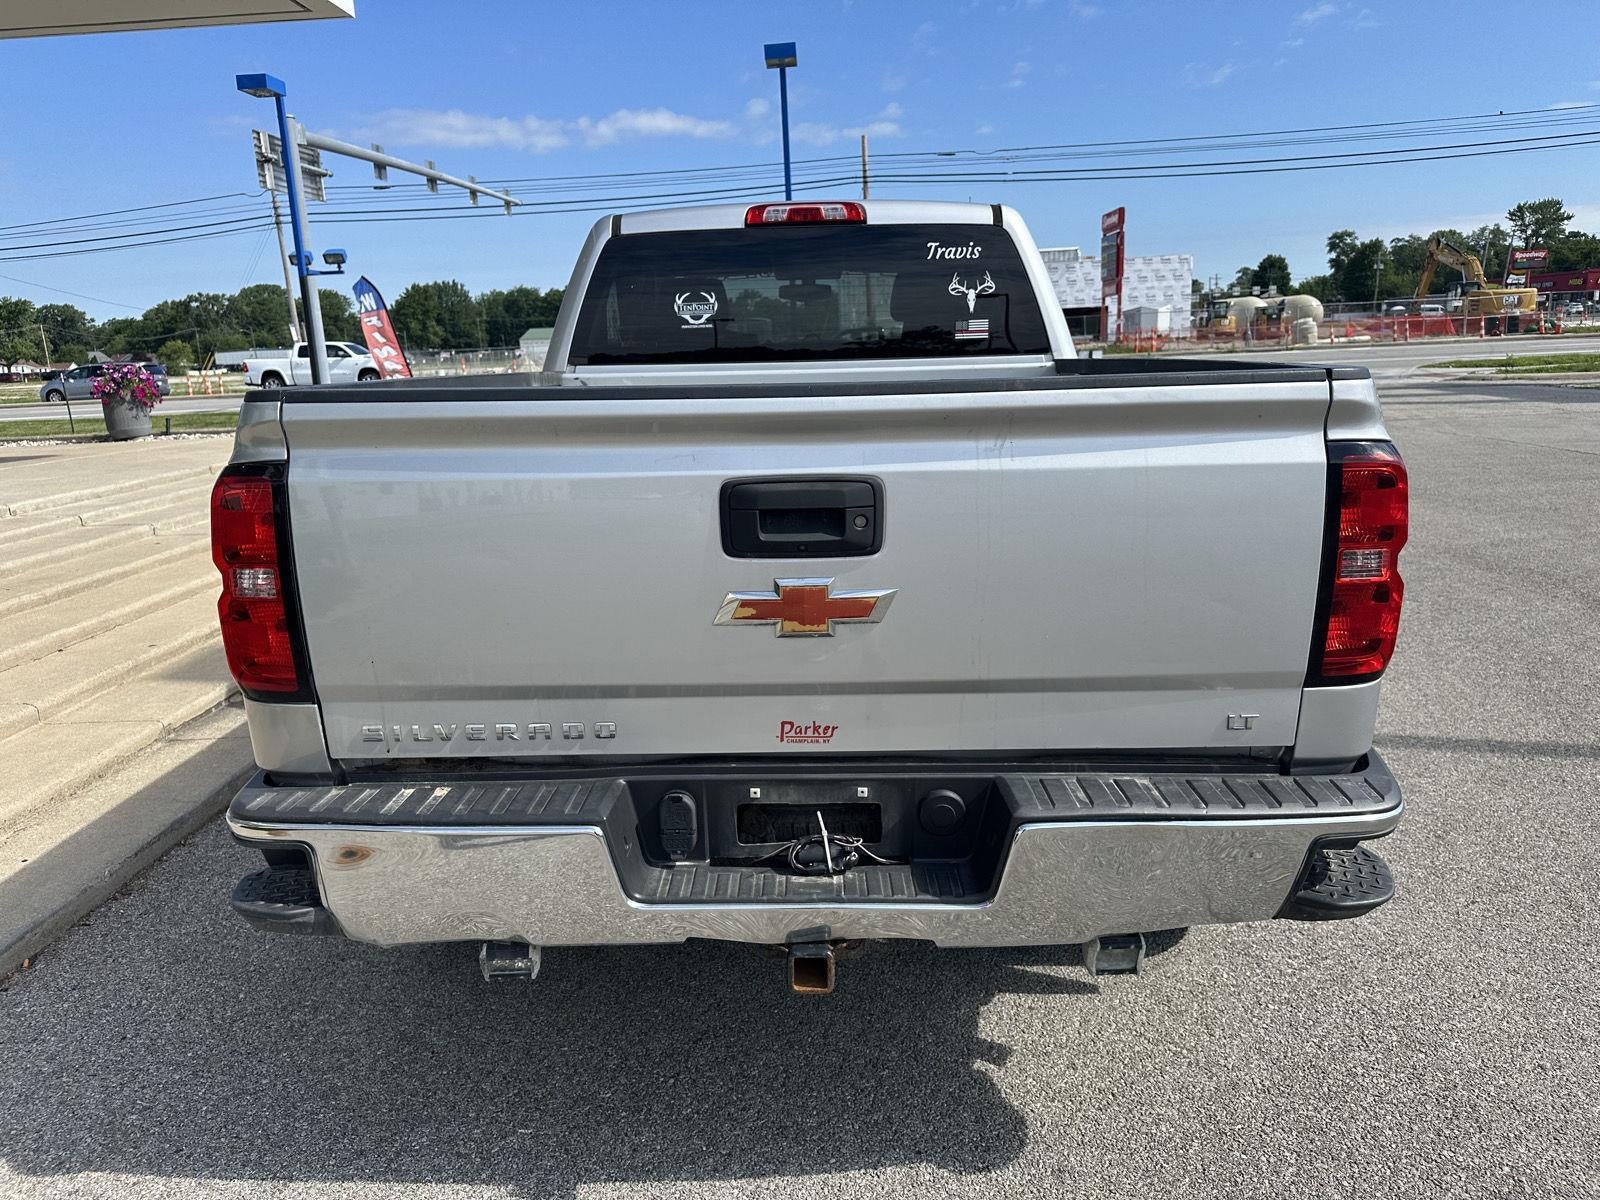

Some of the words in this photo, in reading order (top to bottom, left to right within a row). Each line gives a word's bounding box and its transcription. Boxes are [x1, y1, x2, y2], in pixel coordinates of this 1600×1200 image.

[926, 241, 982, 260] Travis
[1502, 294, 1519, 306] CAT
[361, 721, 617, 742] SILVERADO
[780, 720, 839, 743] Parker
[1227, 713, 1260, 731] LT
